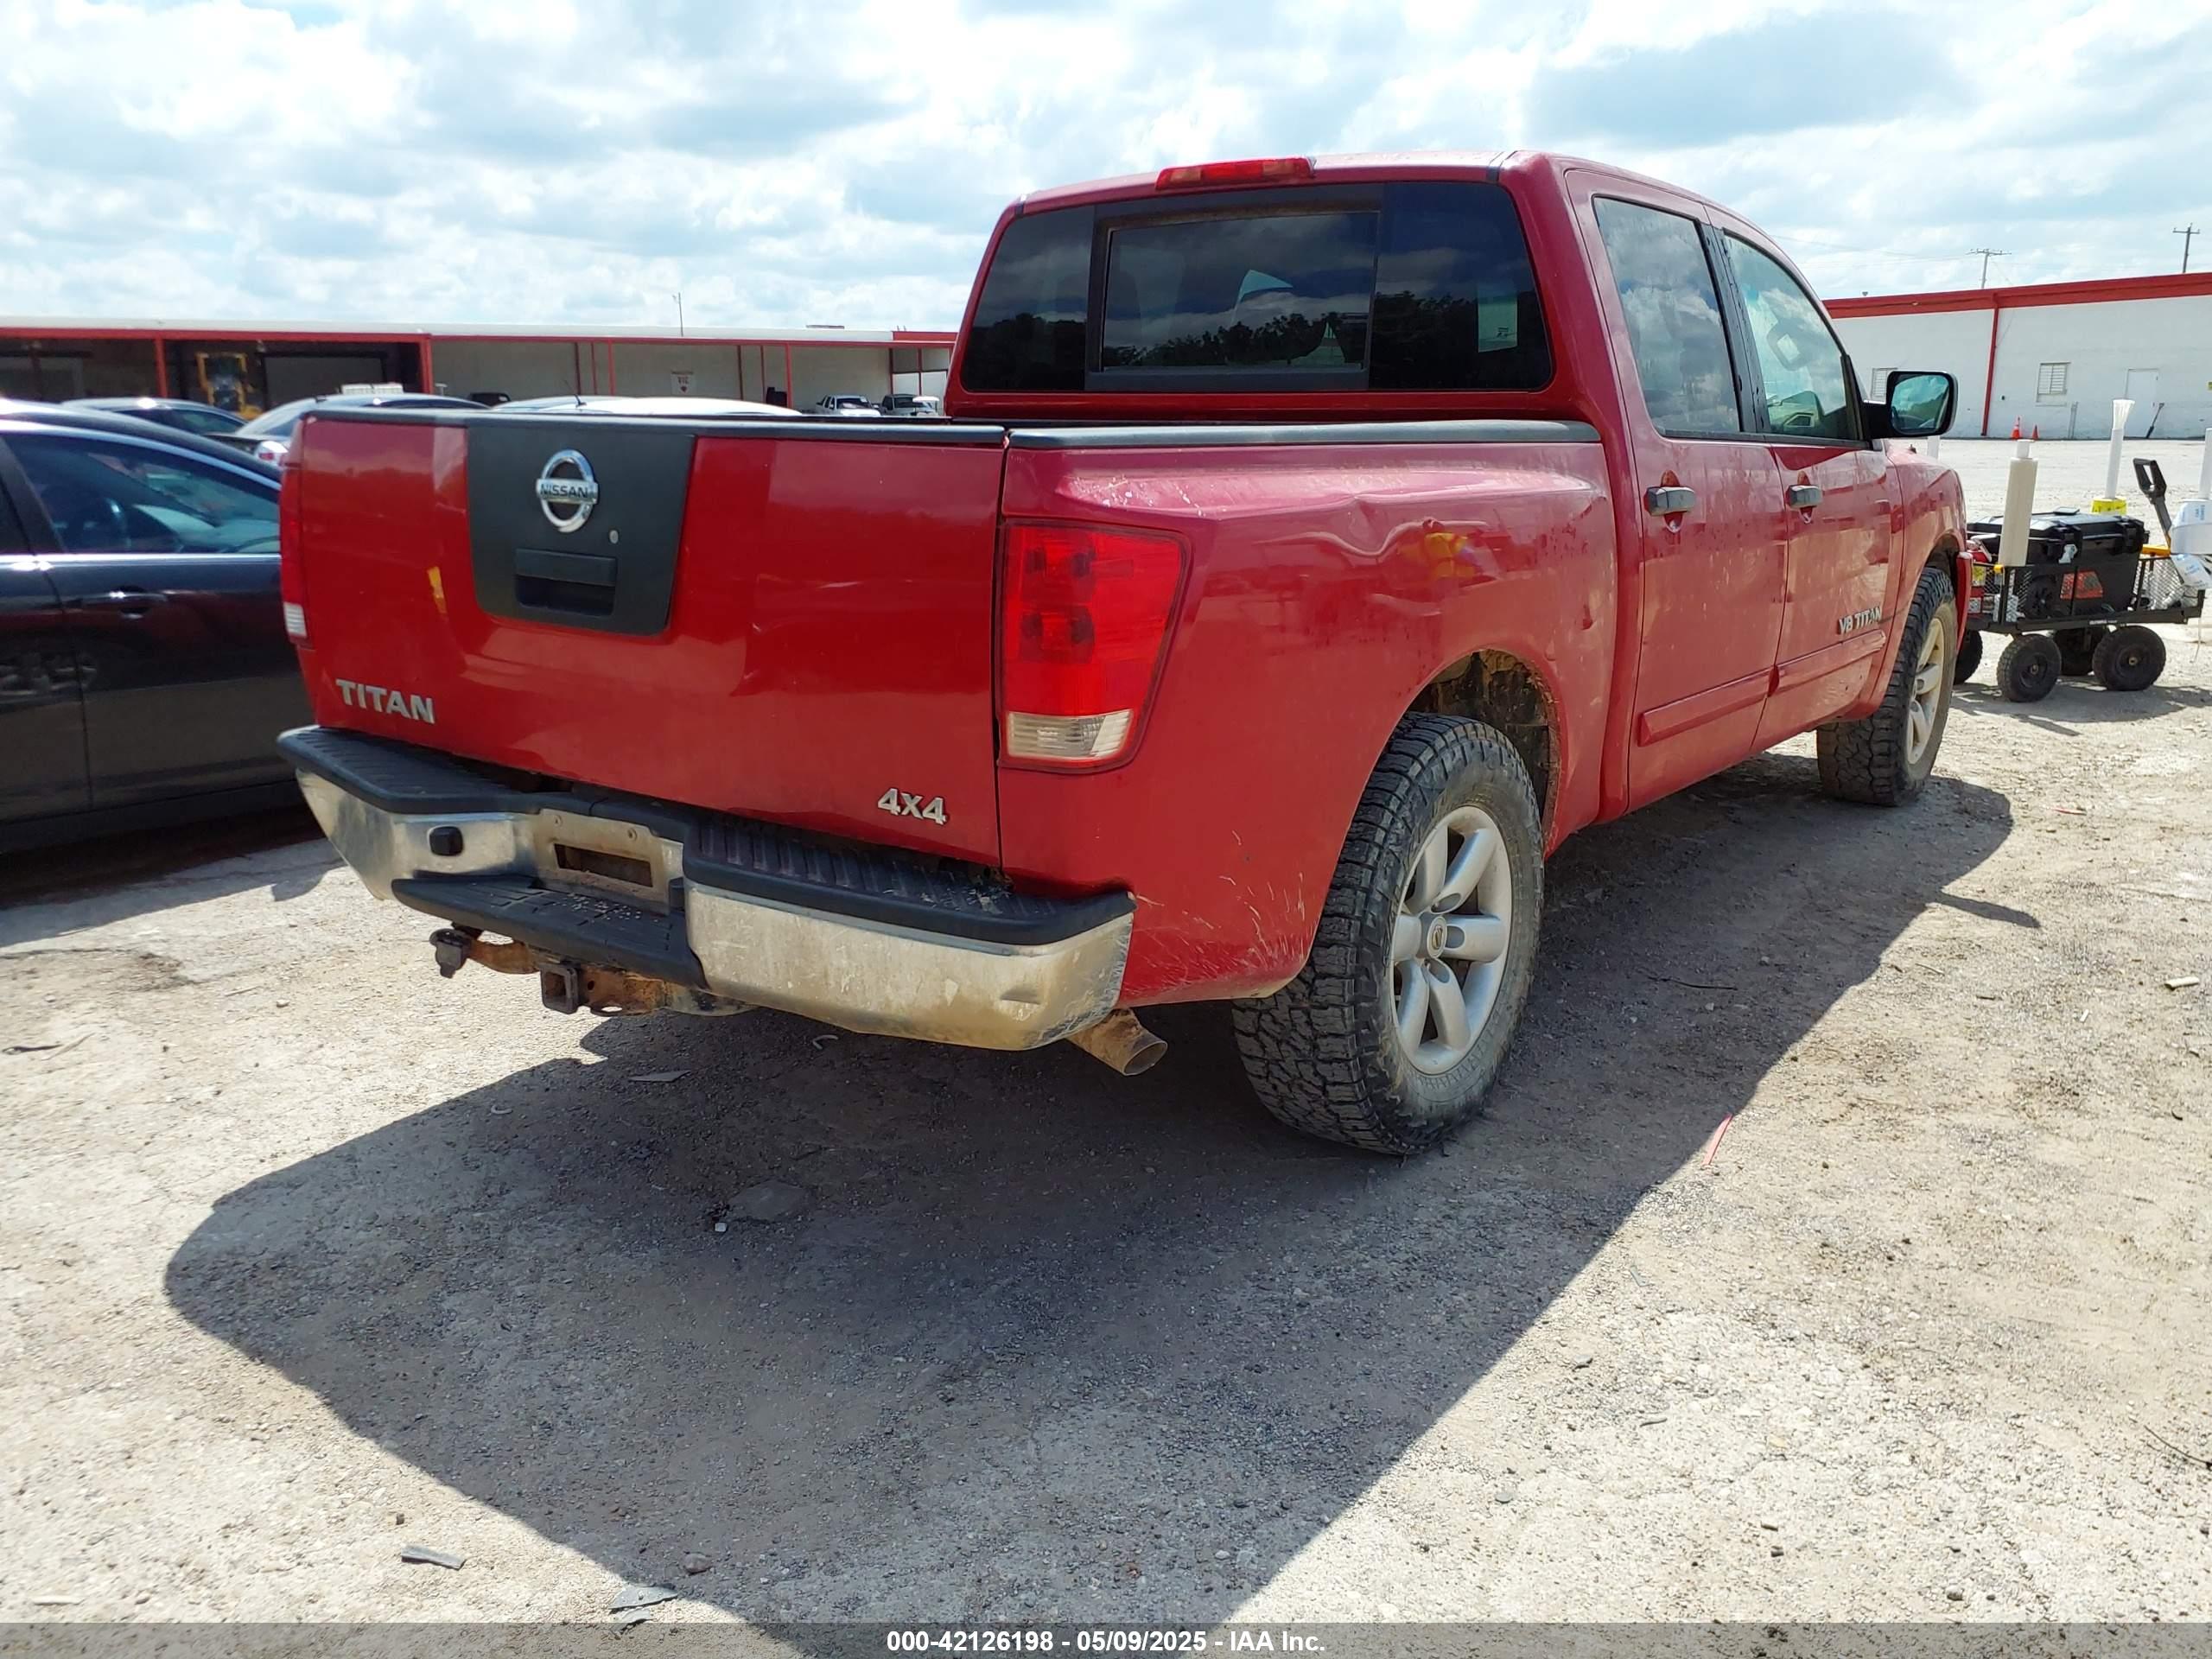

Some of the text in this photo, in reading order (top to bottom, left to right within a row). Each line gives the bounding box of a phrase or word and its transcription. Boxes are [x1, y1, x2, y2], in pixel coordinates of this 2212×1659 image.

[540, 483, 588, 499] NISSAN
[1838, 606, 1881, 634] V8 TITAN
[335, 678, 435, 724] TITAN
